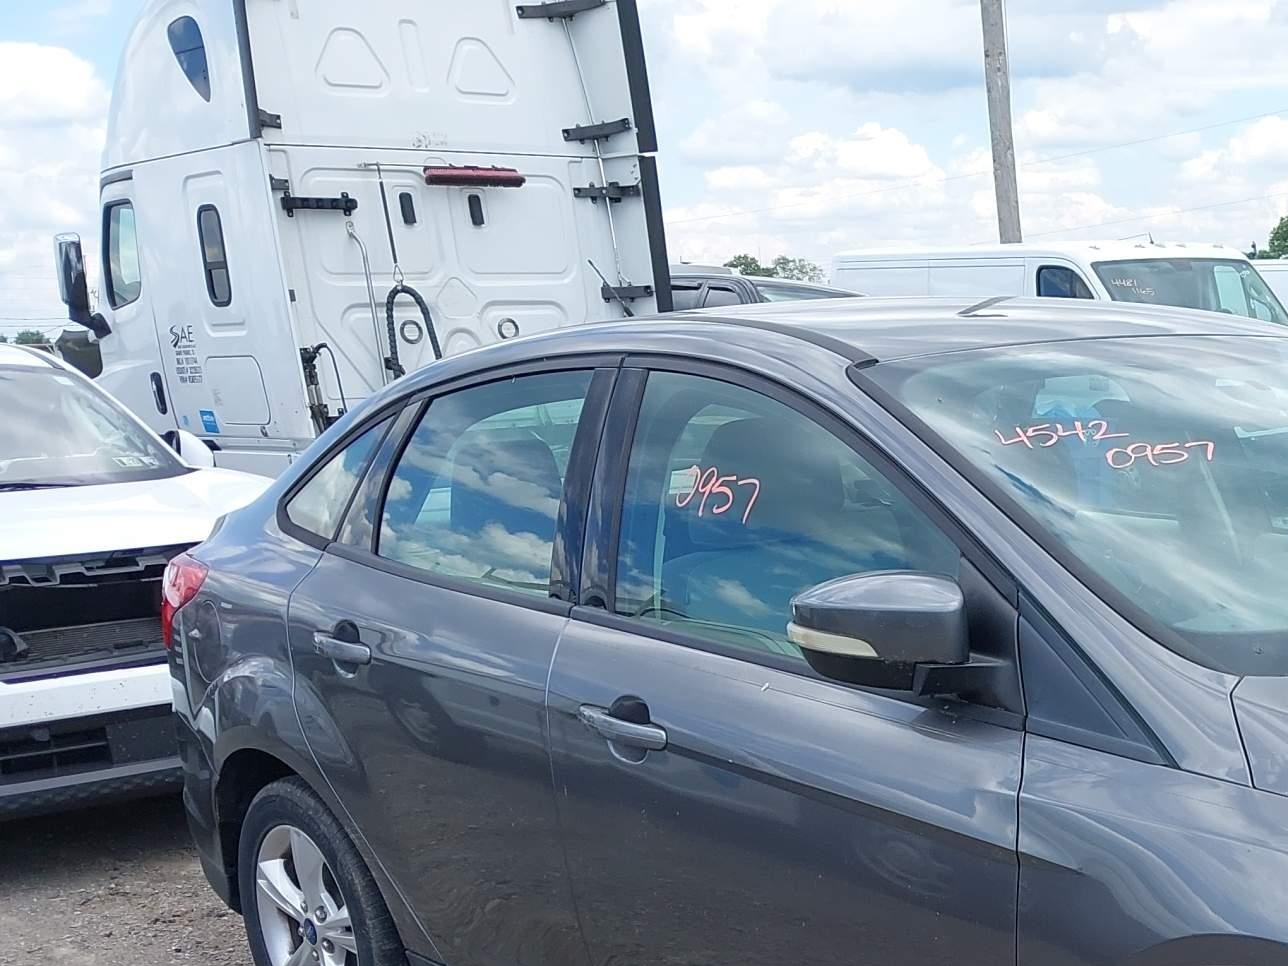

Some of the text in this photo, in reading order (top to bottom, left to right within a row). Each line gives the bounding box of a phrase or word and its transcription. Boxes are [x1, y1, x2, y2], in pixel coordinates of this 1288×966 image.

[169, 324, 195, 348] SAE
[995, 420, 1130, 449] 4542
[1106, 441, 1214, 469] 0957
